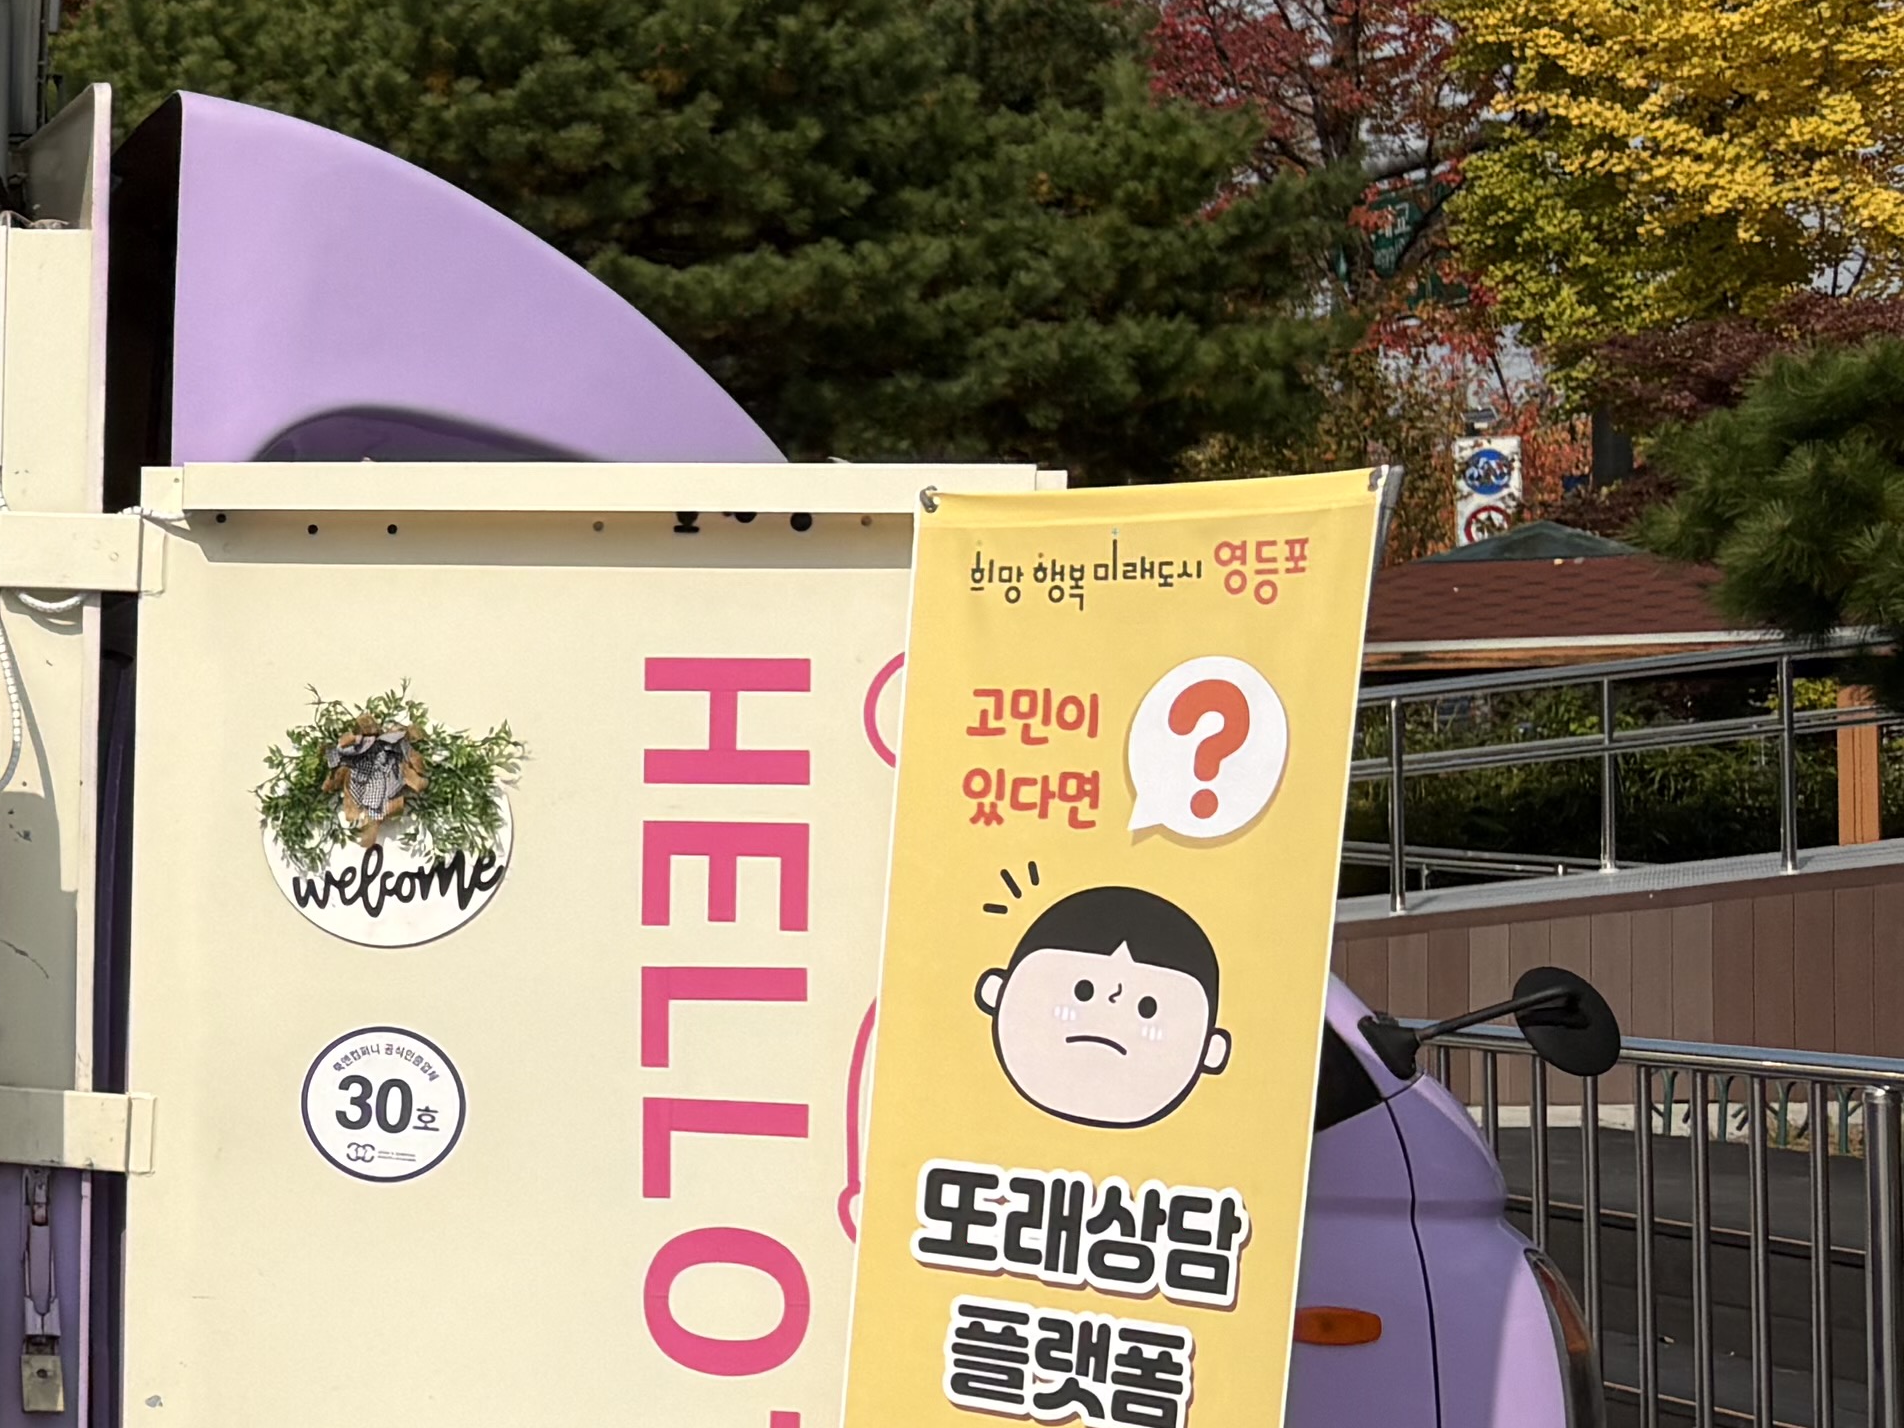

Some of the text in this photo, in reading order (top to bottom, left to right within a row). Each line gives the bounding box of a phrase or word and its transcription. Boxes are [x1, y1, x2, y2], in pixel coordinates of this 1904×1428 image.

[969, 537, 1310, 611] 희망 행복 미래도시 영등포
[965, 686, 1101, 745] 고민이
[1167, 677, 1252, 821] ?
[961, 766, 1103, 831] 있다면
[292, 843, 505, 918] welcome
[916, 1167, 1245, 1300] 또래상담
